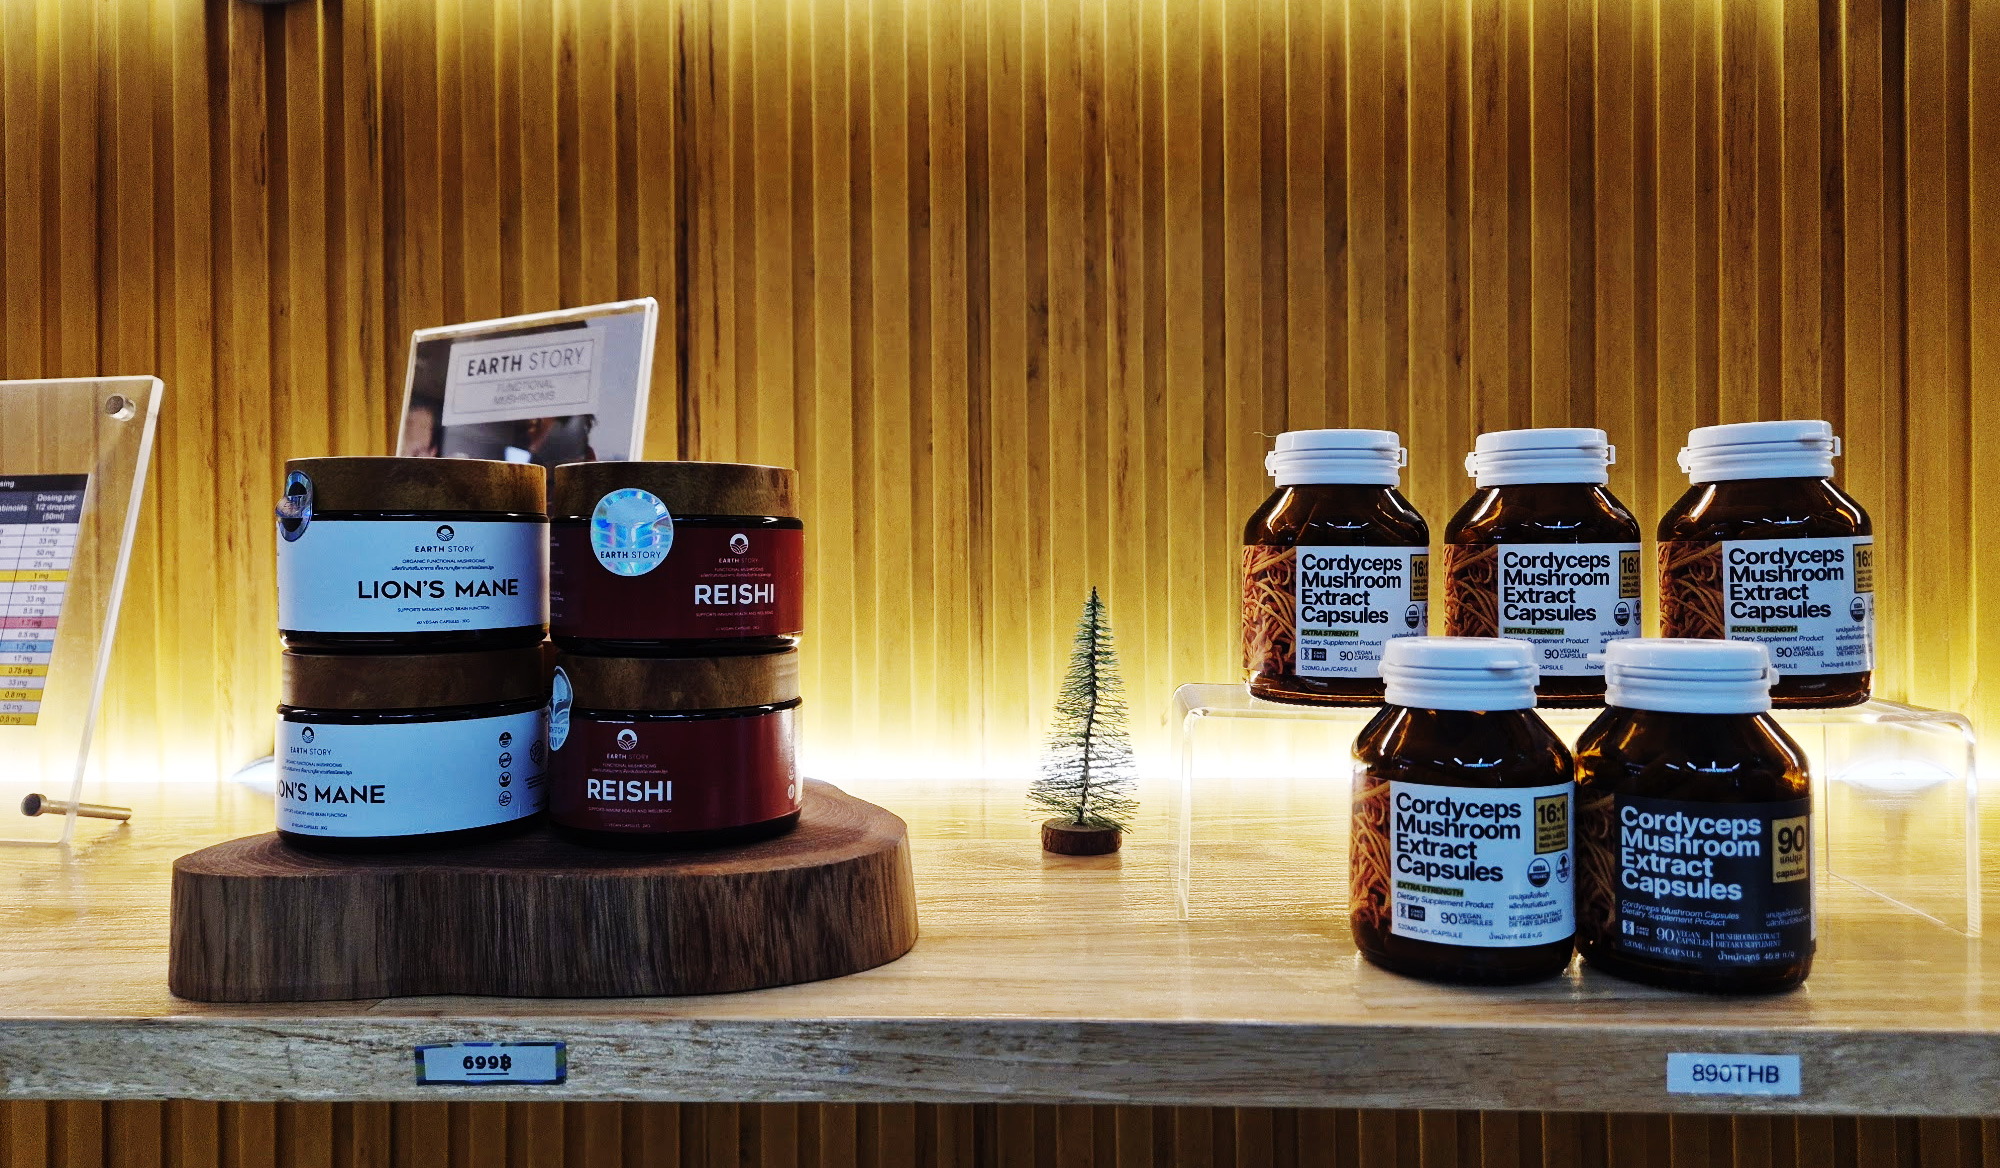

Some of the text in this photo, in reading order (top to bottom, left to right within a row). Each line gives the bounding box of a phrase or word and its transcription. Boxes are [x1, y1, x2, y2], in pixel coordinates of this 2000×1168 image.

[467, 347, 585, 377] EARTH STORY
[37, 494, 76, 502] Dosing per
[600, 551, 661, 559] EARTH STORY
[1302, 554, 1403, 575] Cordyceps
[1504, 552, 1611, 572] Cordyceps
[1729, 547, 1845, 569] Cordyceps
[1301, 572, 1402, 589] Mushroom
[1503, 569, 1610, 586] Mushroom
[1729, 566, 1844, 583] Mushroom
[358, 578, 519, 600] LION'S MANE
[694, 584, 775, 605] REISHI
[1301, 589, 1371, 606] Extract
[1503, 587, 1576, 604] Extract
[1730, 584, 1810, 601] Extract
[1301, 606, 1389, 627] Capsules
[1503, 604, 1597, 625] Capsules
[1730, 601, 1832, 623] Capsules
[1756, 636, 1798, 644] Supplement
[1340, 651, 1354, 661] 90
[1544, 649, 1560, 660] 90
[1776, 647, 1793, 658] 90
[290, 747, 332, 756] EARTH STORY
[315, 785, 386, 804] MANE
[588, 779, 672, 802] REISHI
[1396, 792, 1522, 824] Cordyceps
[1538, 802, 1566, 825] 16:1
[1396, 813, 1521, 840] Mushroom
[1621, 806, 1762, 840] Cordyceps
[1396, 834, 1478, 860] Extract
[1621, 826, 1762, 857] Mushroom
[1778, 825, 1805, 855] 90
[1397, 854, 1504, 882] Capsules
[1621, 847, 1714, 878] Extract
[1776, 868, 1805, 879] capsules
[1397, 881, 1464, 897] EXTRA STRENGTH
[1622, 868, 1742, 901] Capsules
[1397, 892, 1494, 909] Dietary Supplement Product
[1622, 900, 1740, 920] Cordyceps Mushroom Capsules
[1441, 912, 1458, 925] 90
[1509, 915, 1563, 928] DIETARY SUPPLEMENT
[1622, 907, 1726, 927] Dietary Supplement Product
[1656, 927, 1701, 942] 90 VEGAN
[1676, 938, 1711, 947] CAPSULES
[1715, 933, 1757, 941] MUSHROOM
[1744, 940, 1781, 948] SUPPLEMENT
[1692, 1064, 1780, 1084] 890THB
